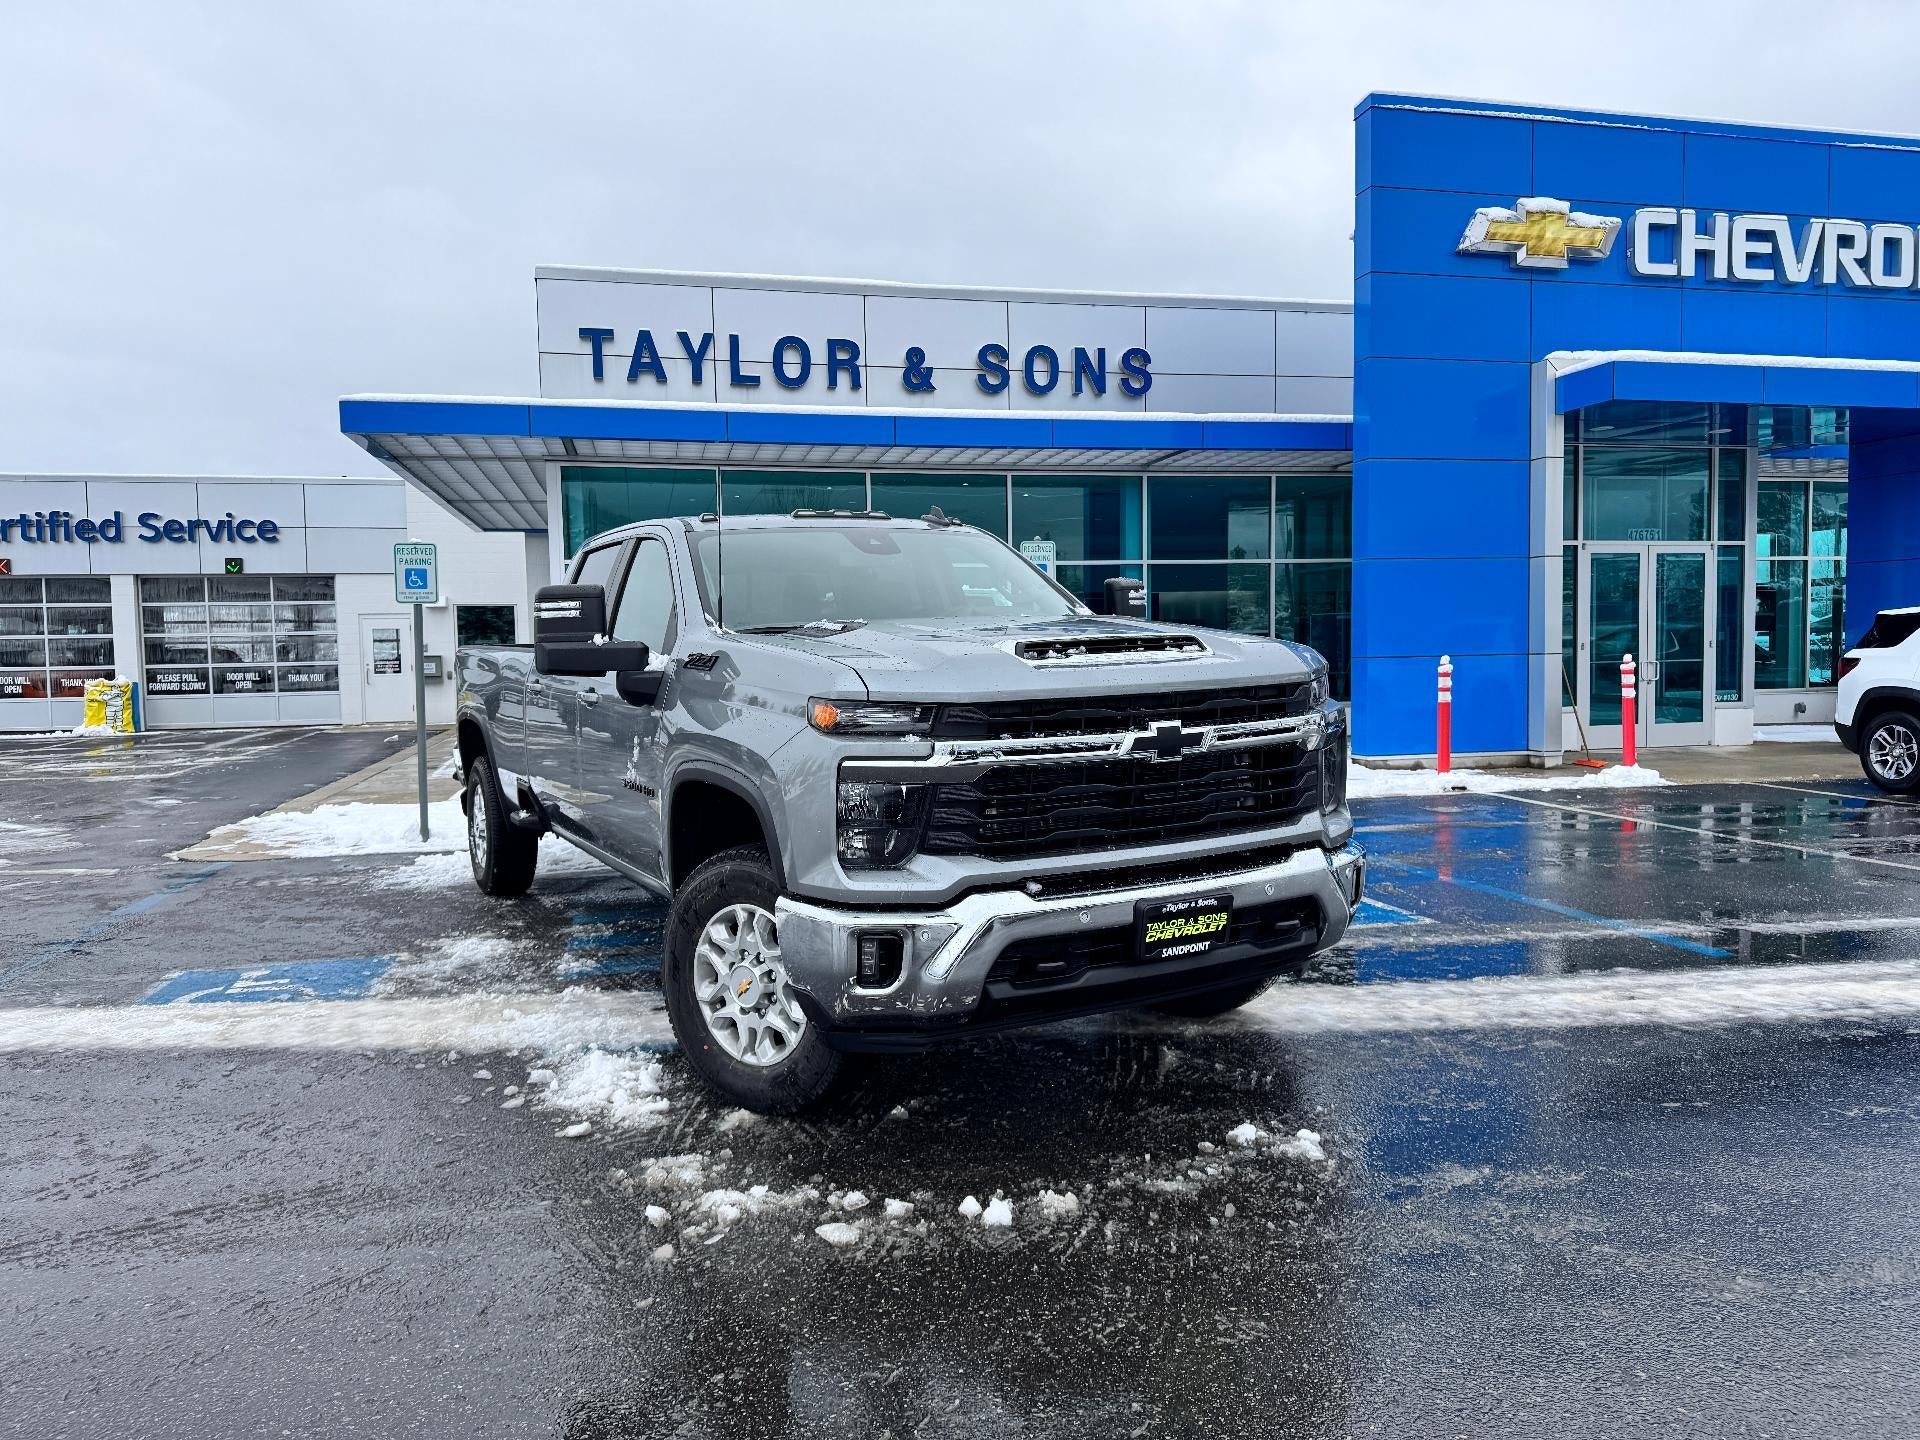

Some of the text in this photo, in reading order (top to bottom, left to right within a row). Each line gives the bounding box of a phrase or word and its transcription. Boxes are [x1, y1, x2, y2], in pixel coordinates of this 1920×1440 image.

[1629, 208, 1920, 288] CHEVRO
[579, 327, 1153, 398] TAYLOR & SONS
[0, 510, 280, 544] rtified Service
[397, 547, 433, 555] RESERVED
[399, 557, 432, 566] PARKING
[0, 676, 31, 685] OOR WILL
[156, 673, 199, 682] PLEASE PULL
[226, 672, 260, 681] DOOR WILL
[288, 673, 325, 682] THANK YOU!
[61, 678, 83, 687] THANK
[149, 681, 206, 691] FORWARD SLOWLY
[235, 680, 252, 689] OPEN
[4, 685, 22, 694] OPEN
[1166, 903, 1190, 912] Taylor
[1196, 899, 1214, 907] Sons
[1147, 912, 1228, 932] TAYLOR & SONS
[1146, 921, 1226, 942] CHEVROLET
[1162, 942, 1210, 957] SANDPOINT
